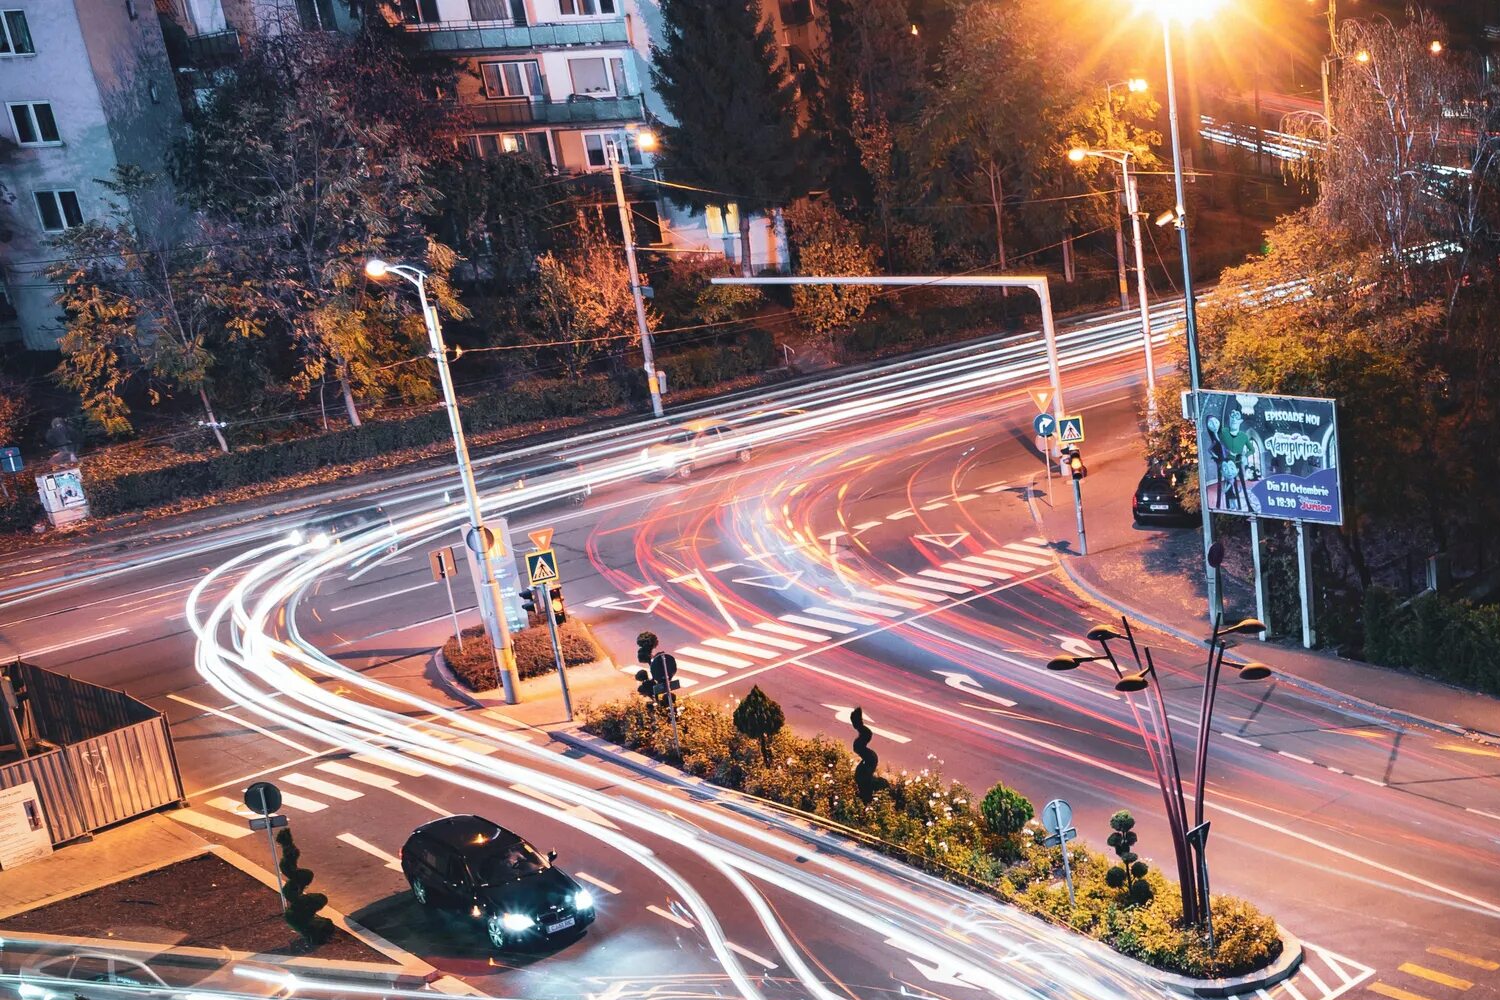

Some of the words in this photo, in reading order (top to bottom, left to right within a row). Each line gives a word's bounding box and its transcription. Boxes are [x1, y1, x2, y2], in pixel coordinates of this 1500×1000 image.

[1264, 410, 1304, 423] EPISOADE
[1305, 413, 1320, 426] NOI
[1265, 436, 1321, 464] Vampirina
[1266, 480, 1280, 491] Din
[1280, 482, 1289, 492] 21
[1290, 483, 1329, 496] Octombrie
[1268, 496, 1275, 506] la
